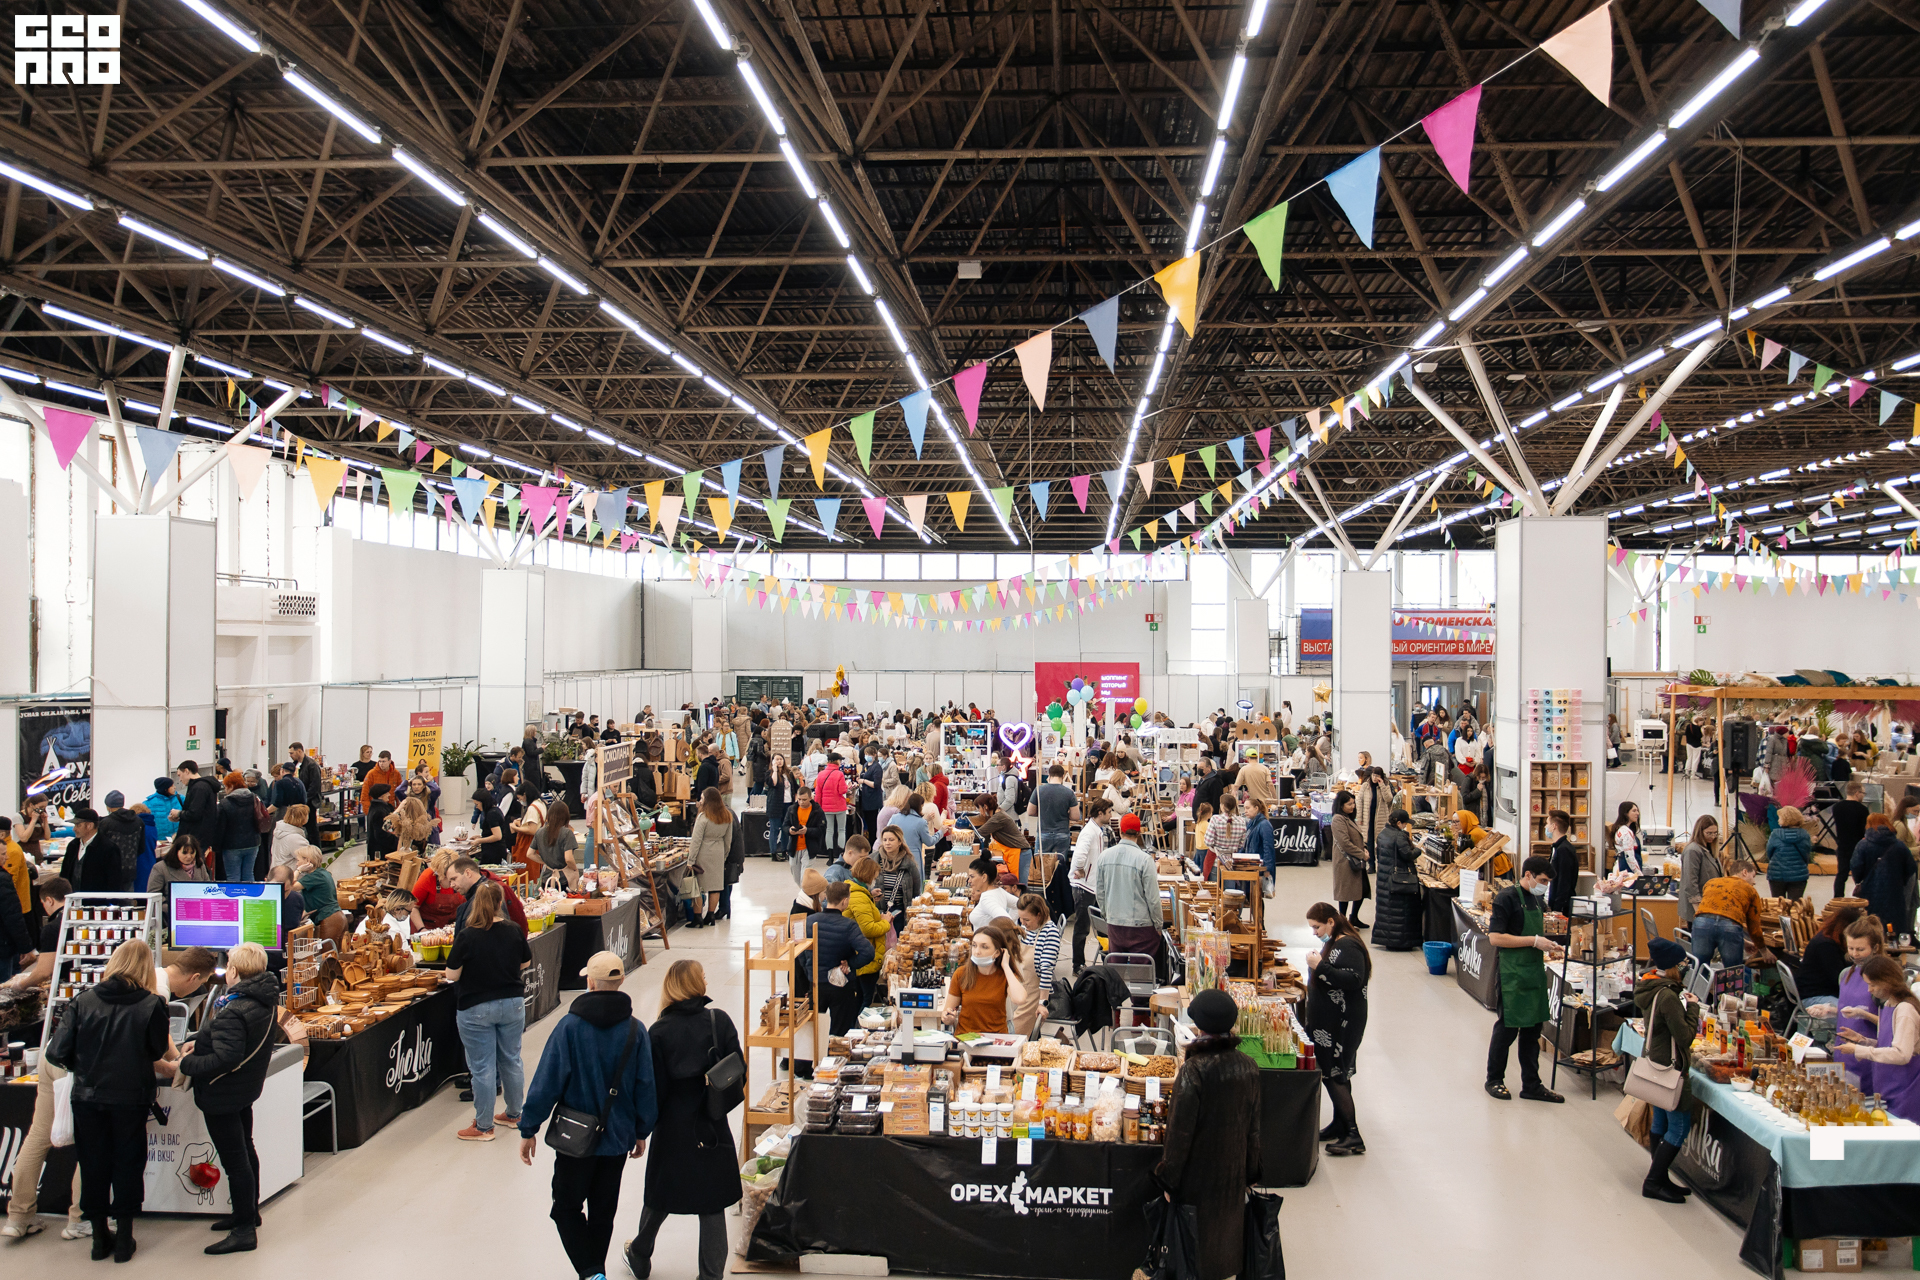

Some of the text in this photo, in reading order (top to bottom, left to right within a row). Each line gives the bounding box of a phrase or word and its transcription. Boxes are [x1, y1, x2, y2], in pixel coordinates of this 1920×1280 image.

[1303, 642, 1332, 653] ВЫСТА
[1409, 643, 1457, 653] ОРИЕНТИР
[1458, 643, 1465, 653] В
[1466, 643, 1491, 653] МИРЕ
[413, 730, 437, 738] НЕДЕЛЯ
[413, 744, 426, 757] 70
[63, 783, 91, 804] Севе
[1273, 824, 1317, 853] Igolka
[385, 1022, 433, 1094] Igolka
[167, 1133, 181, 1146] ВАС
[157, 1149, 175, 1162] ВКУС
[950, 1183, 1114, 1206] ОРЕХ МАРКЕТ
